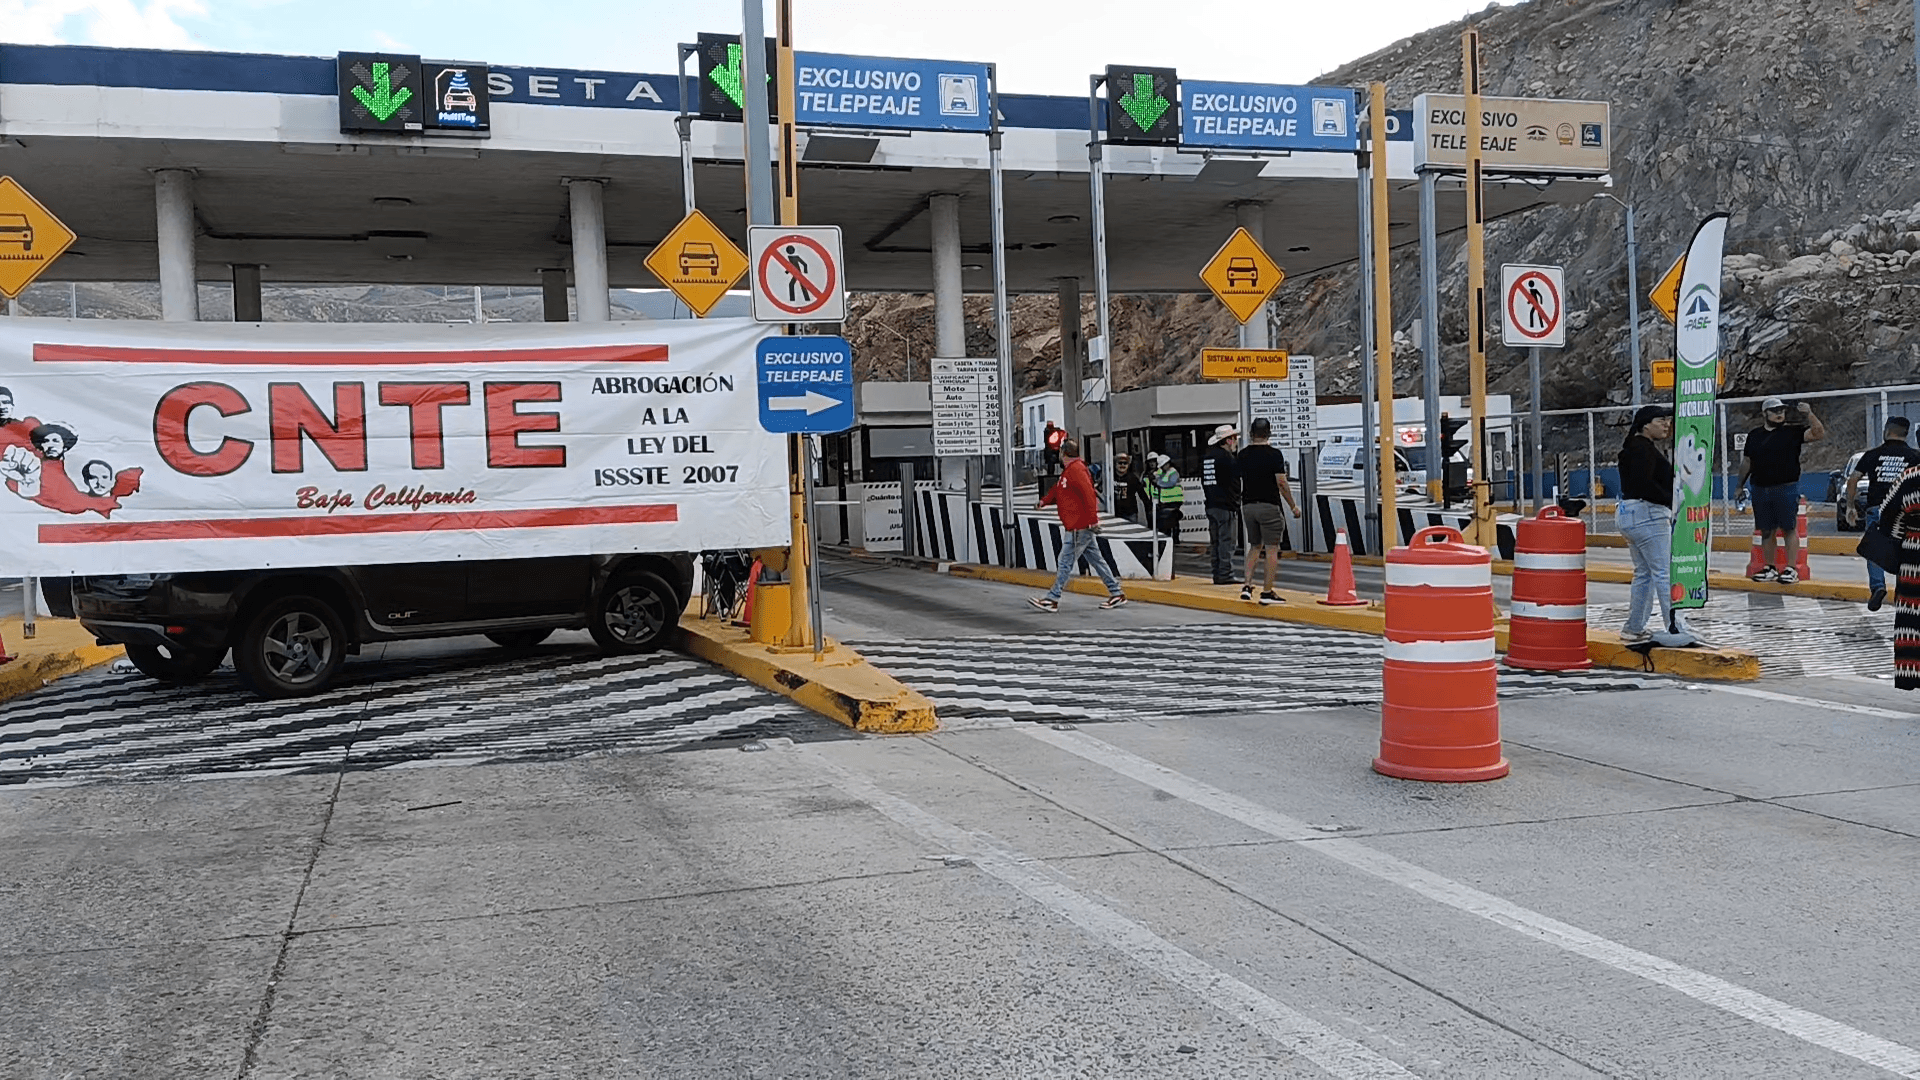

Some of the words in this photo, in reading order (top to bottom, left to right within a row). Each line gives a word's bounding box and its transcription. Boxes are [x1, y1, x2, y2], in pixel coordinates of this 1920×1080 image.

[799, 67, 921, 91] EXCLUSIVO
[800, 92, 921, 115] TELEPEAJE
[1192, 94, 1297, 114] EXCLUSIVO
[1193, 116, 1297, 136] TELEPEAJE
[1430, 110, 1518, 127] EXCLSIVO
[1431, 134, 1518, 151] TELEEAJE
[765, 352, 844, 364] EXCLUSIVO
[1256, 355, 1282, 363] EVASIÓN
[592, 372, 734, 394] ABROGACIÓN
[766, 370, 844, 382] TELEPEAJE
[642, 408, 657, 425] A
[662, 408, 689, 425] LA
[153, 381, 567, 477] CNTE
[1190, 430, 1197, 447] 1
[627, 437, 666, 455] LEY
[672, 435, 715, 454] DEL
[594, 466, 671, 487] ISSSTE
[683, 465, 739, 484] 2007
[296, 486, 354, 514] Baja
[363, 484, 477, 512] California
[866, 494, 896, 502] ¿Cuánto
